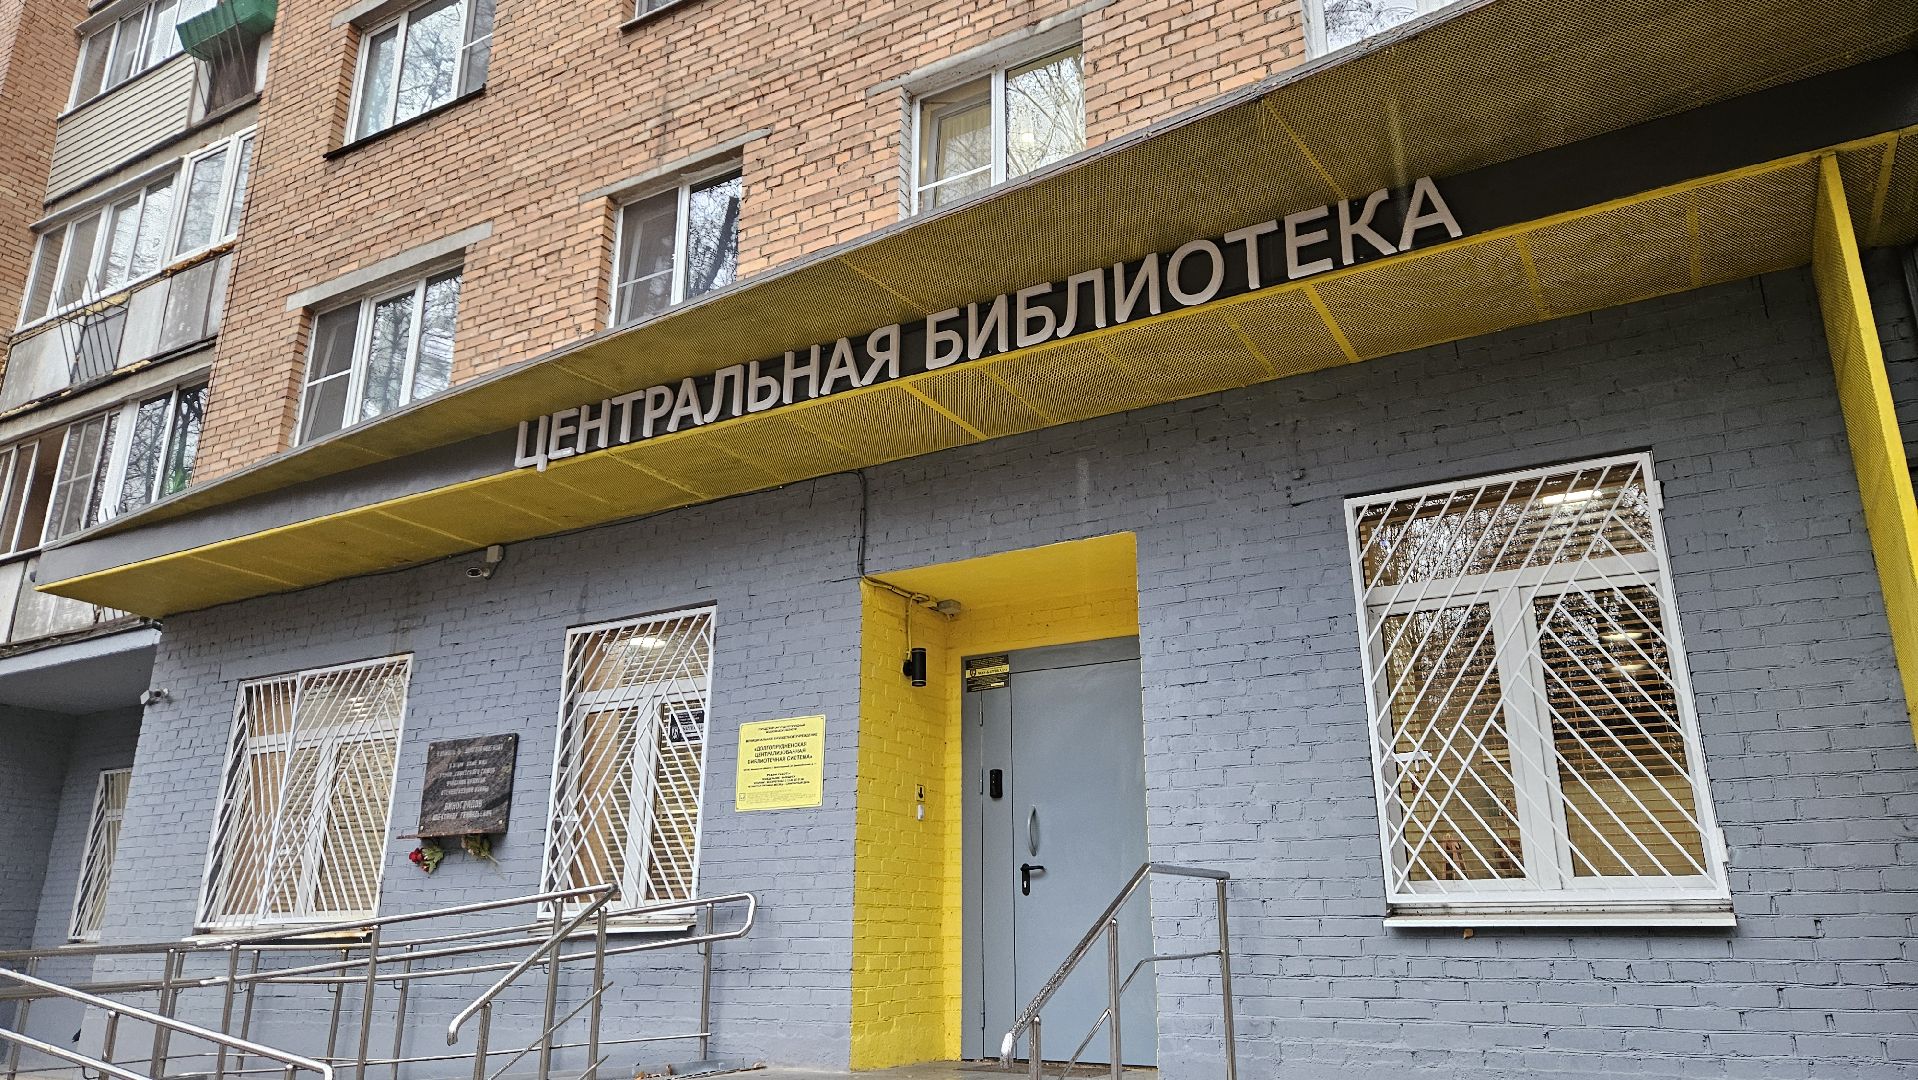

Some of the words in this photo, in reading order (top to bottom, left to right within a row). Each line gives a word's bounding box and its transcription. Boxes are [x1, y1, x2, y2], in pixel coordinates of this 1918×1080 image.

[514, 323, 900, 471] ЦЕНТРАЛЬНАЯ
[925, 176, 1462, 370] БИБЛИОТЕКА
[747, 757, 786, 765] БИБЛИОТЕЧНАЯ
